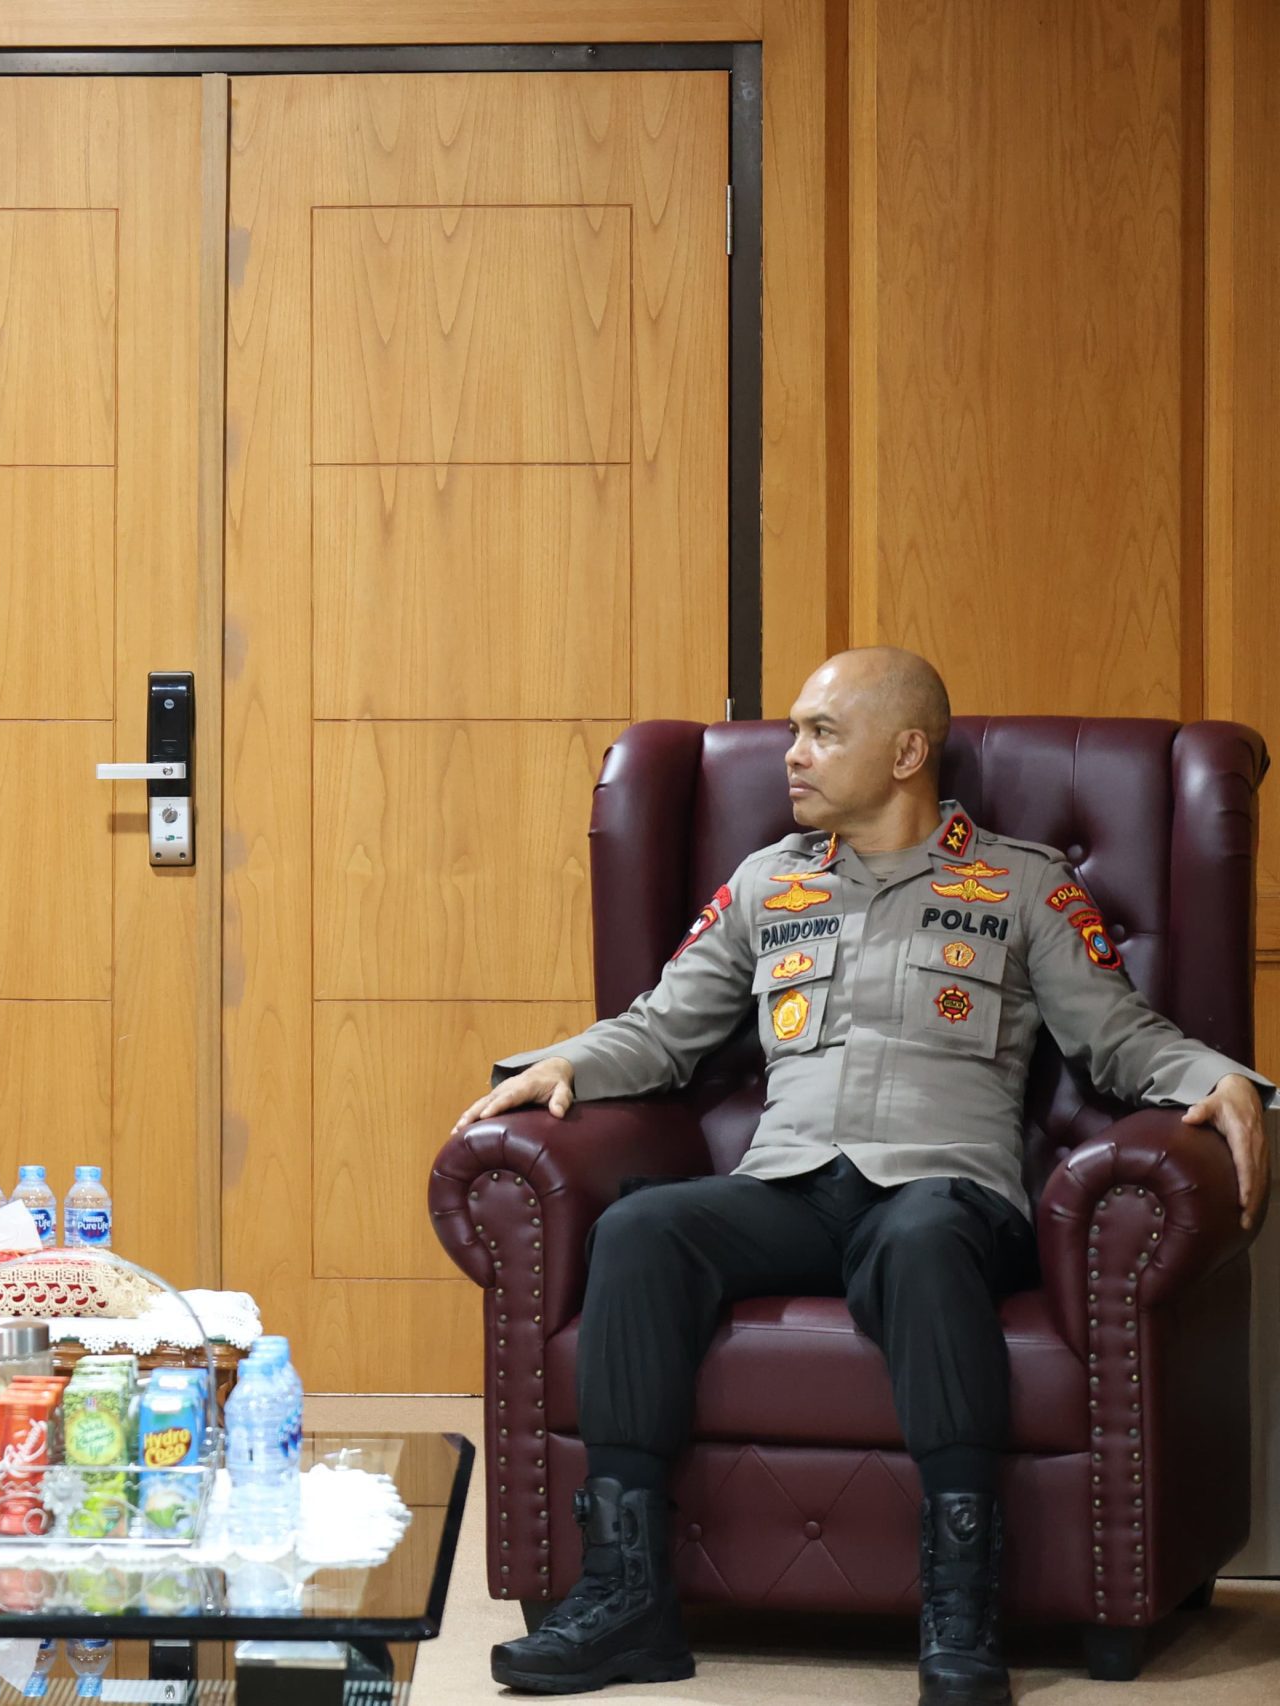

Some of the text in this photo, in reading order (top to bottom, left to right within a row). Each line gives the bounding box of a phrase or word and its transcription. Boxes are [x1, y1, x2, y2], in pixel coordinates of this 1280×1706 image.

[761, 916, 839, 951] PANDOWO
[922, 907, 1008, 940] POLRI
[77, 1221, 97, 1230] Pure
[144, 1428, 190, 1448] Hydro
